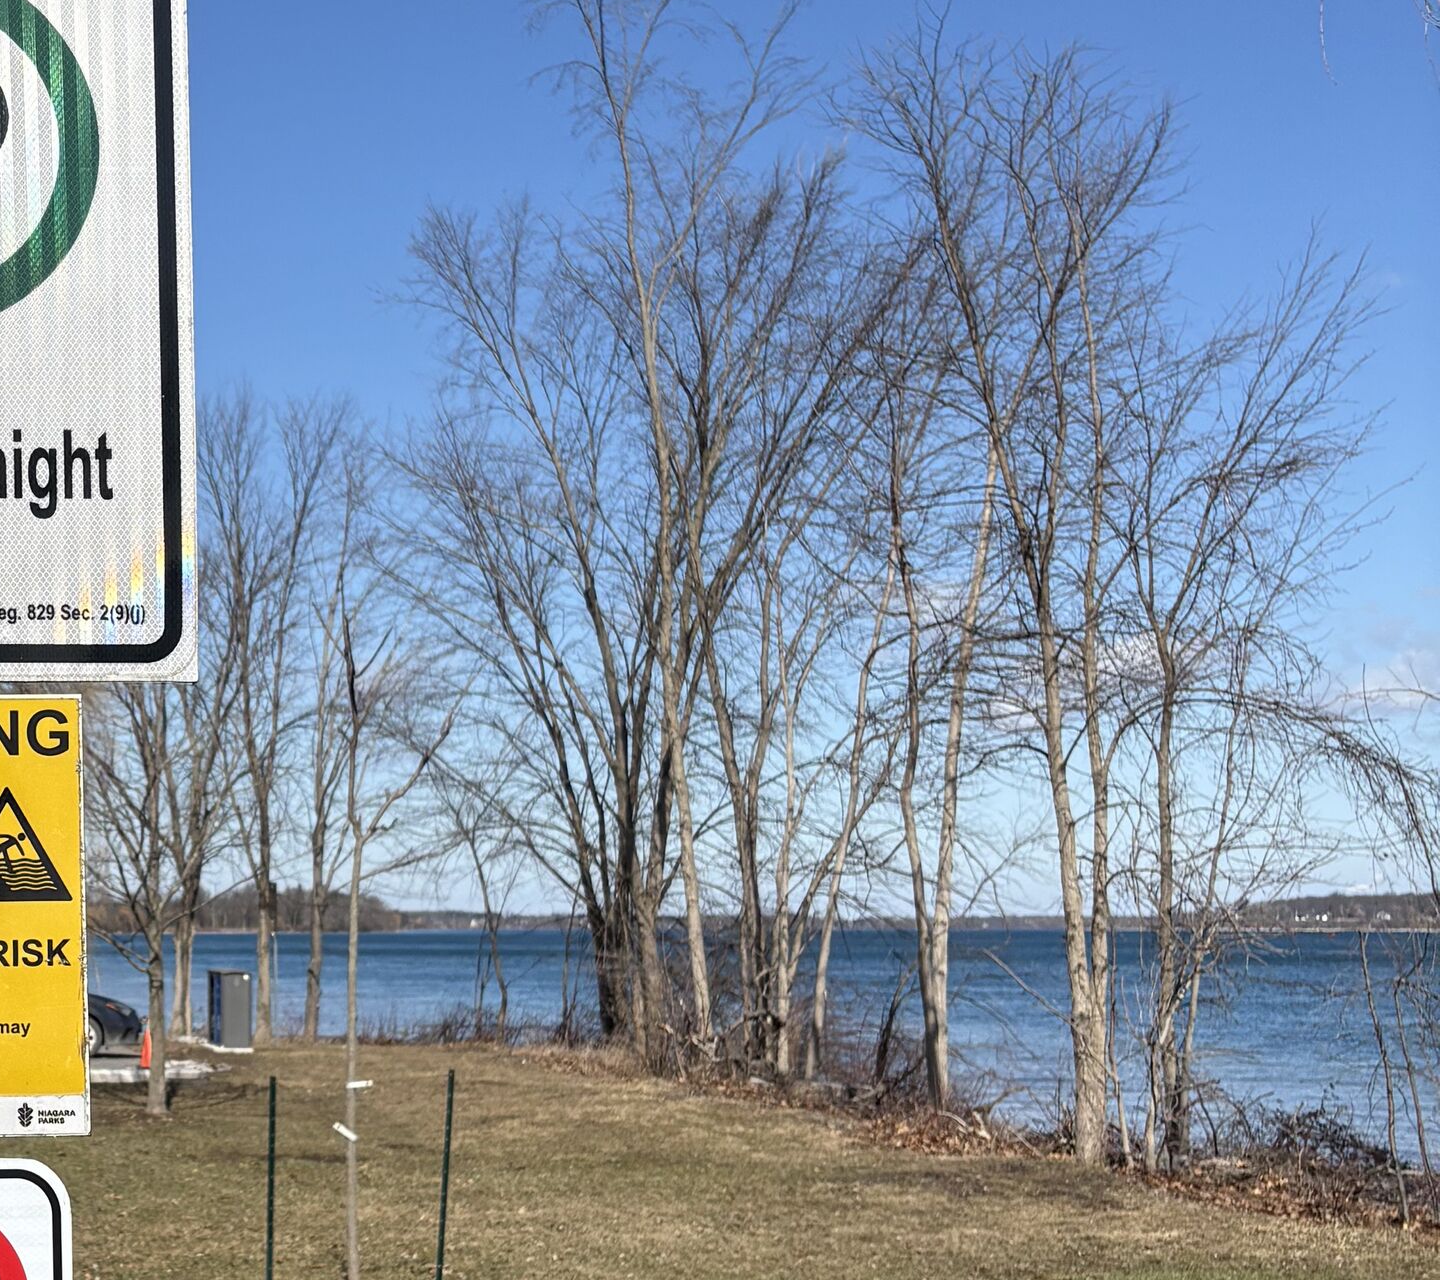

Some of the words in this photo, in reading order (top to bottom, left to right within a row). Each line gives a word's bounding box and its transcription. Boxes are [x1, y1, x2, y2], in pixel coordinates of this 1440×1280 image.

[27, 604, 55, 621] 829
[60, 604, 95, 621] Sec.
[37, 1109, 76, 1117] NIAGARA
[38, 1117, 65, 1125] PARKS
